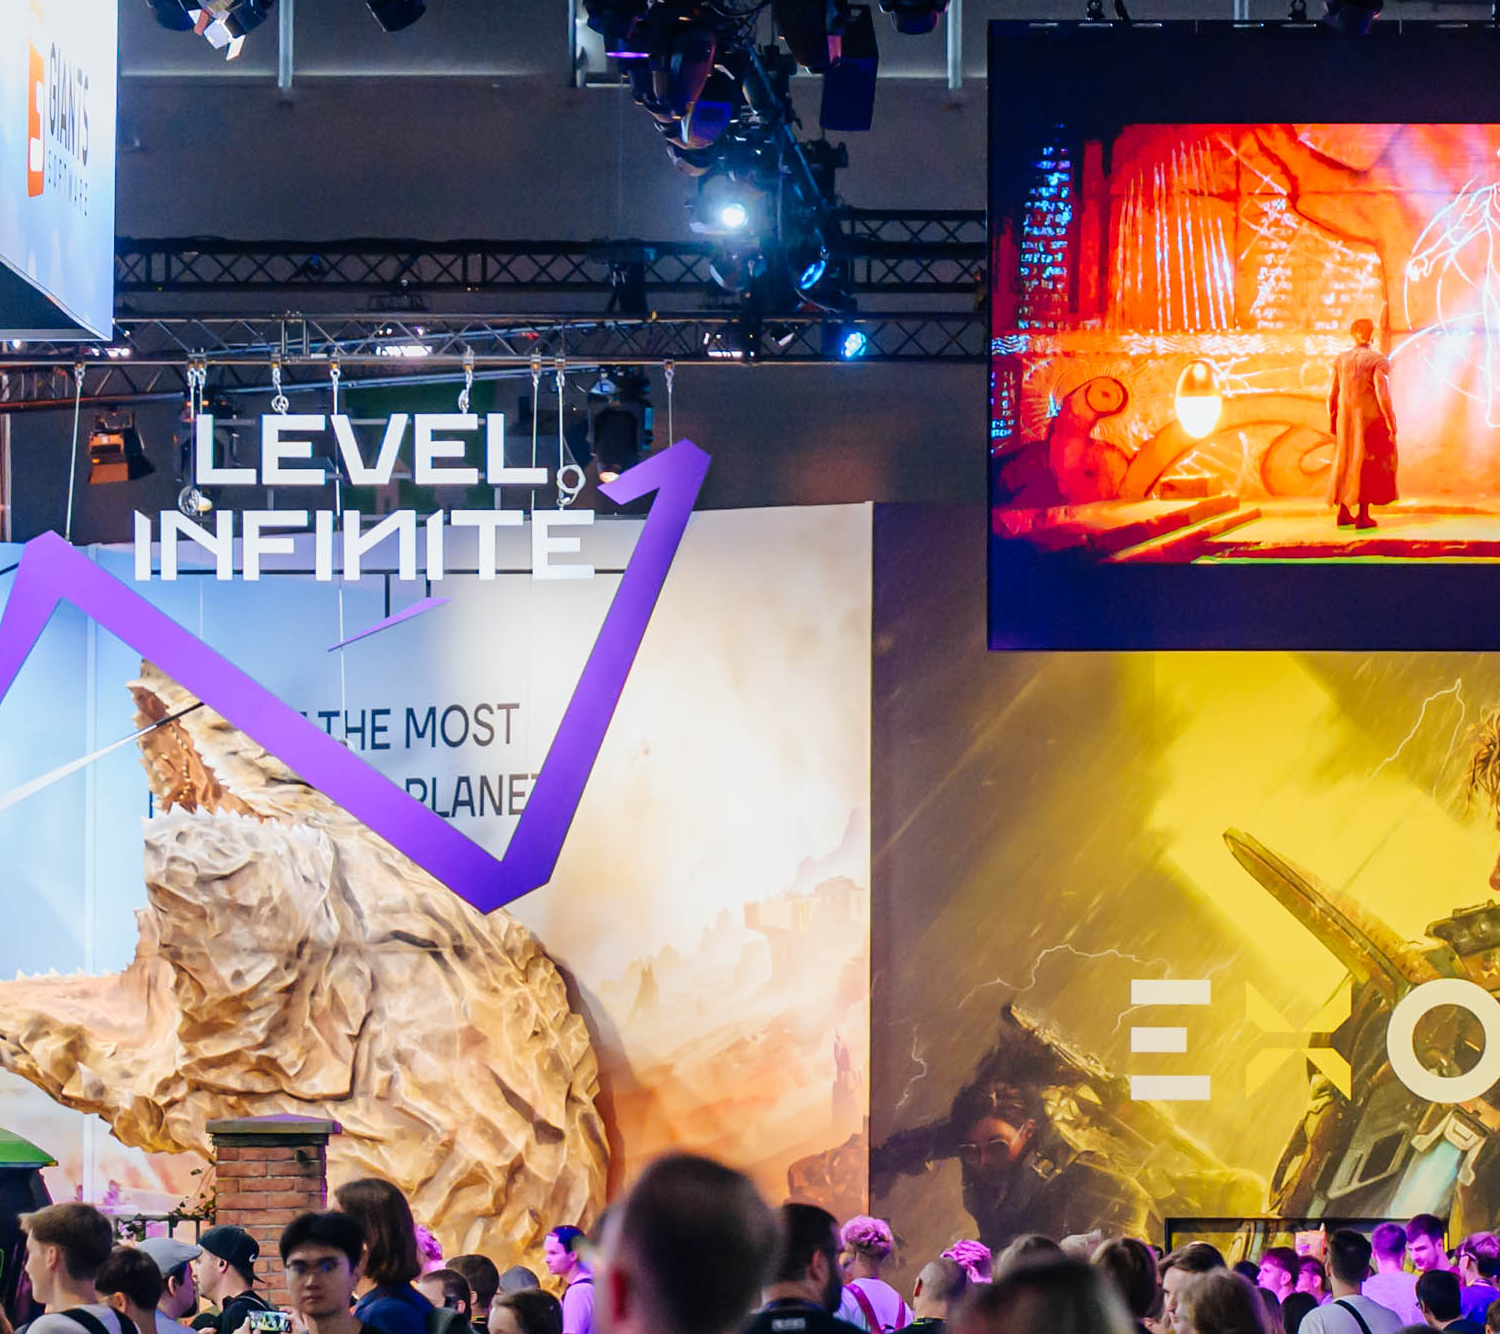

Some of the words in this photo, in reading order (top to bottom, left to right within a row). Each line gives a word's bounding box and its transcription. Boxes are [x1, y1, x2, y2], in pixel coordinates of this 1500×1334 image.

[49, 42, 90, 167] GIANTS
[196, 413, 548, 486] LEVEL
[135, 509, 595, 582] INFINITE
[405, 703, 520, 749] MOST
[405, 773, 540, 818] PLANE
